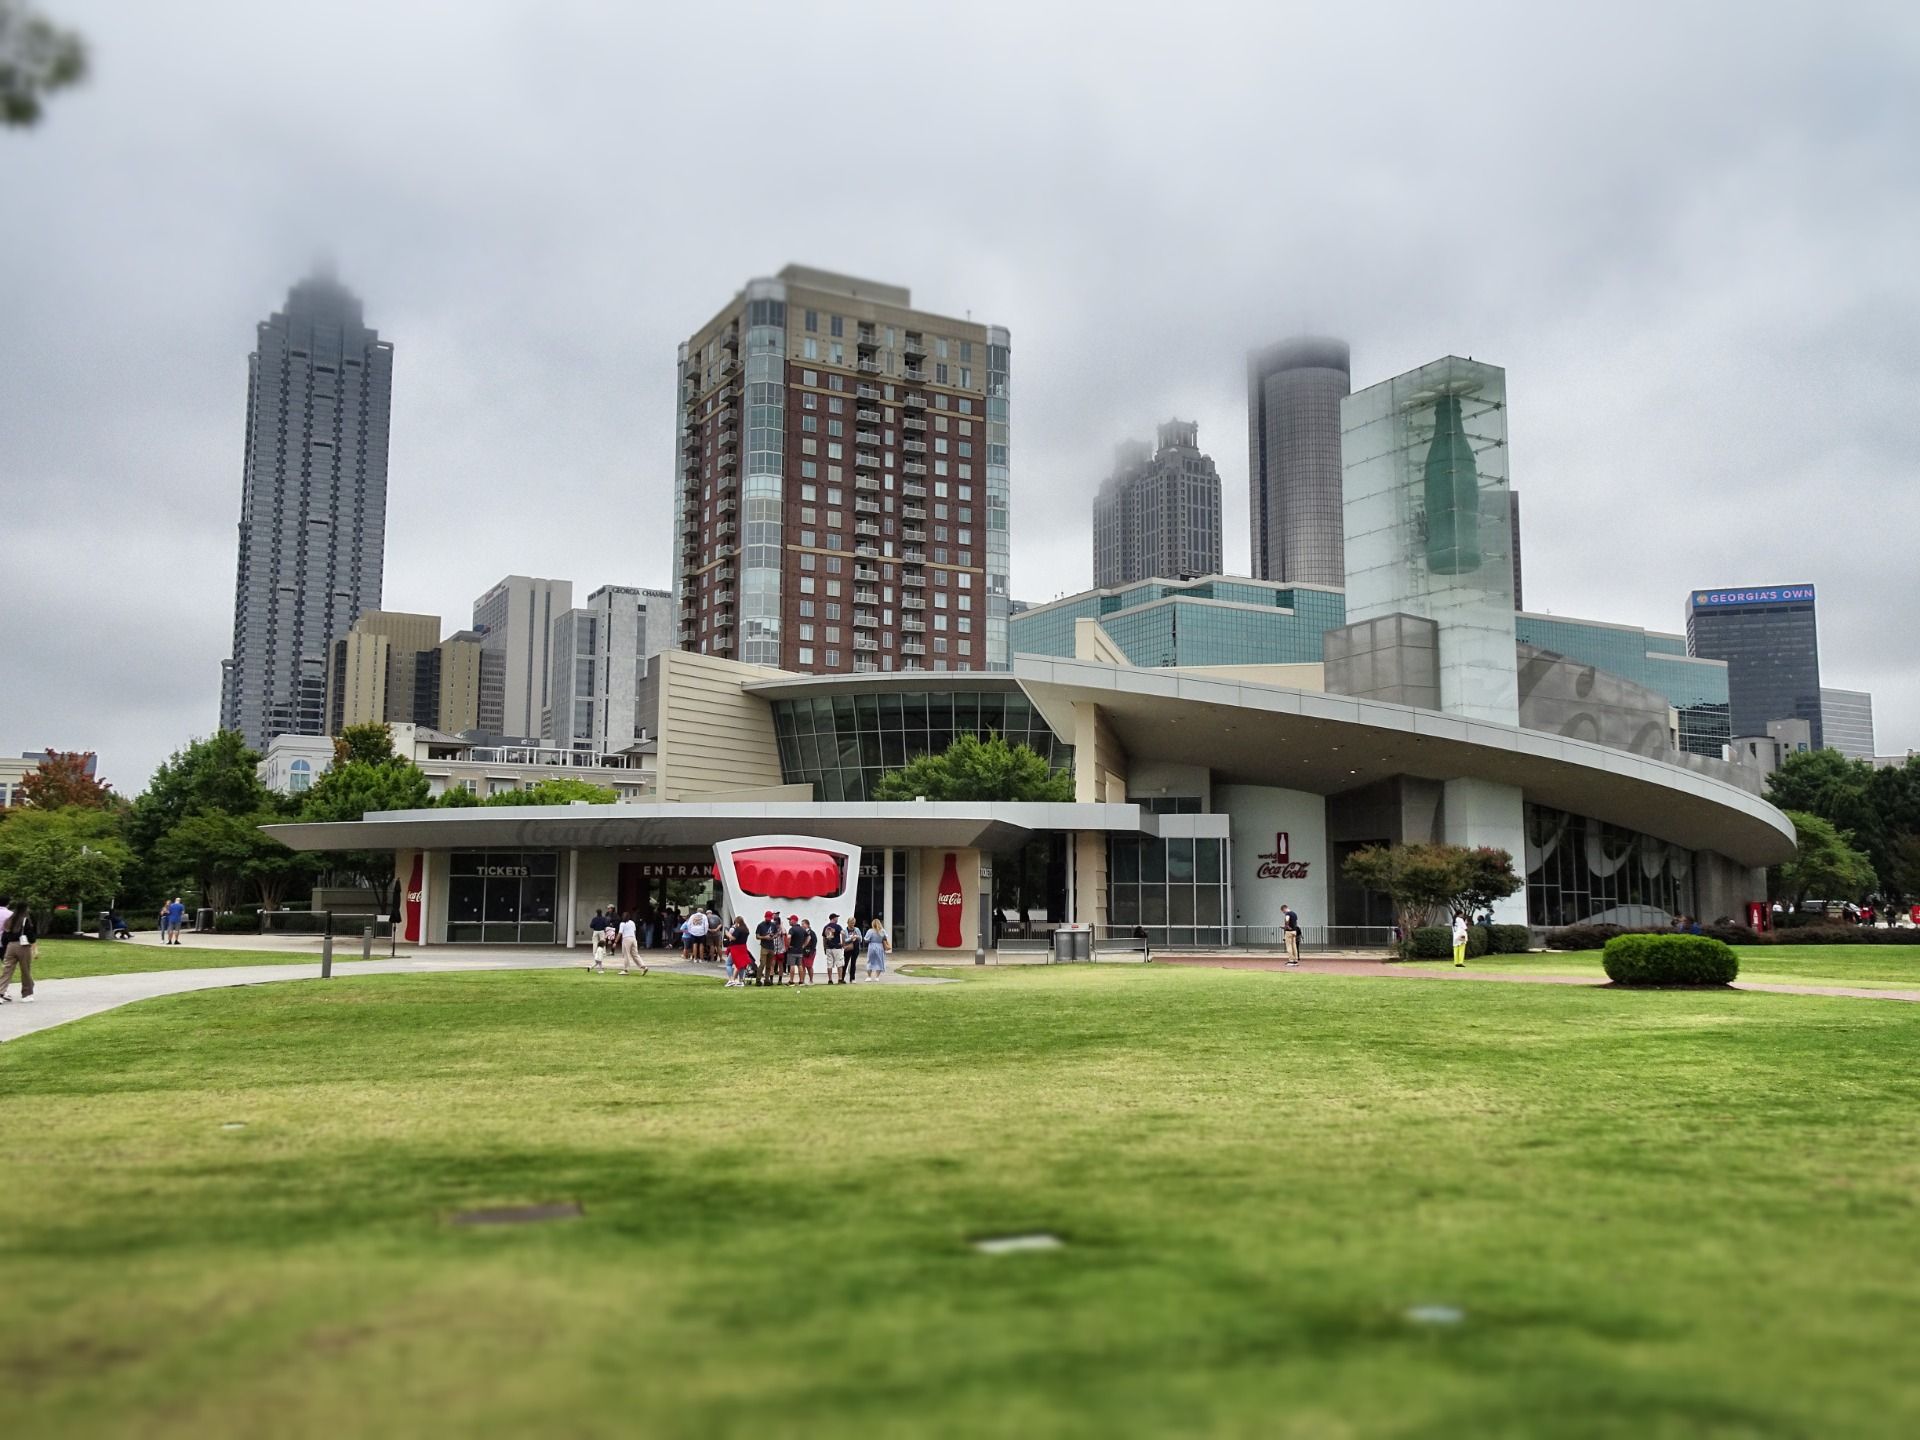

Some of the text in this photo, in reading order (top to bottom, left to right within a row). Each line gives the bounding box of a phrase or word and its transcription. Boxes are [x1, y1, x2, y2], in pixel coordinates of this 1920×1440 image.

[612, 587, 640, 596] GEORGIA
[1710, 589, 1813, 603] GEORGIA'S OWN
[476, 866, 528, 876] TICKETS
[643, 866, 713, 876] ENTRAN
